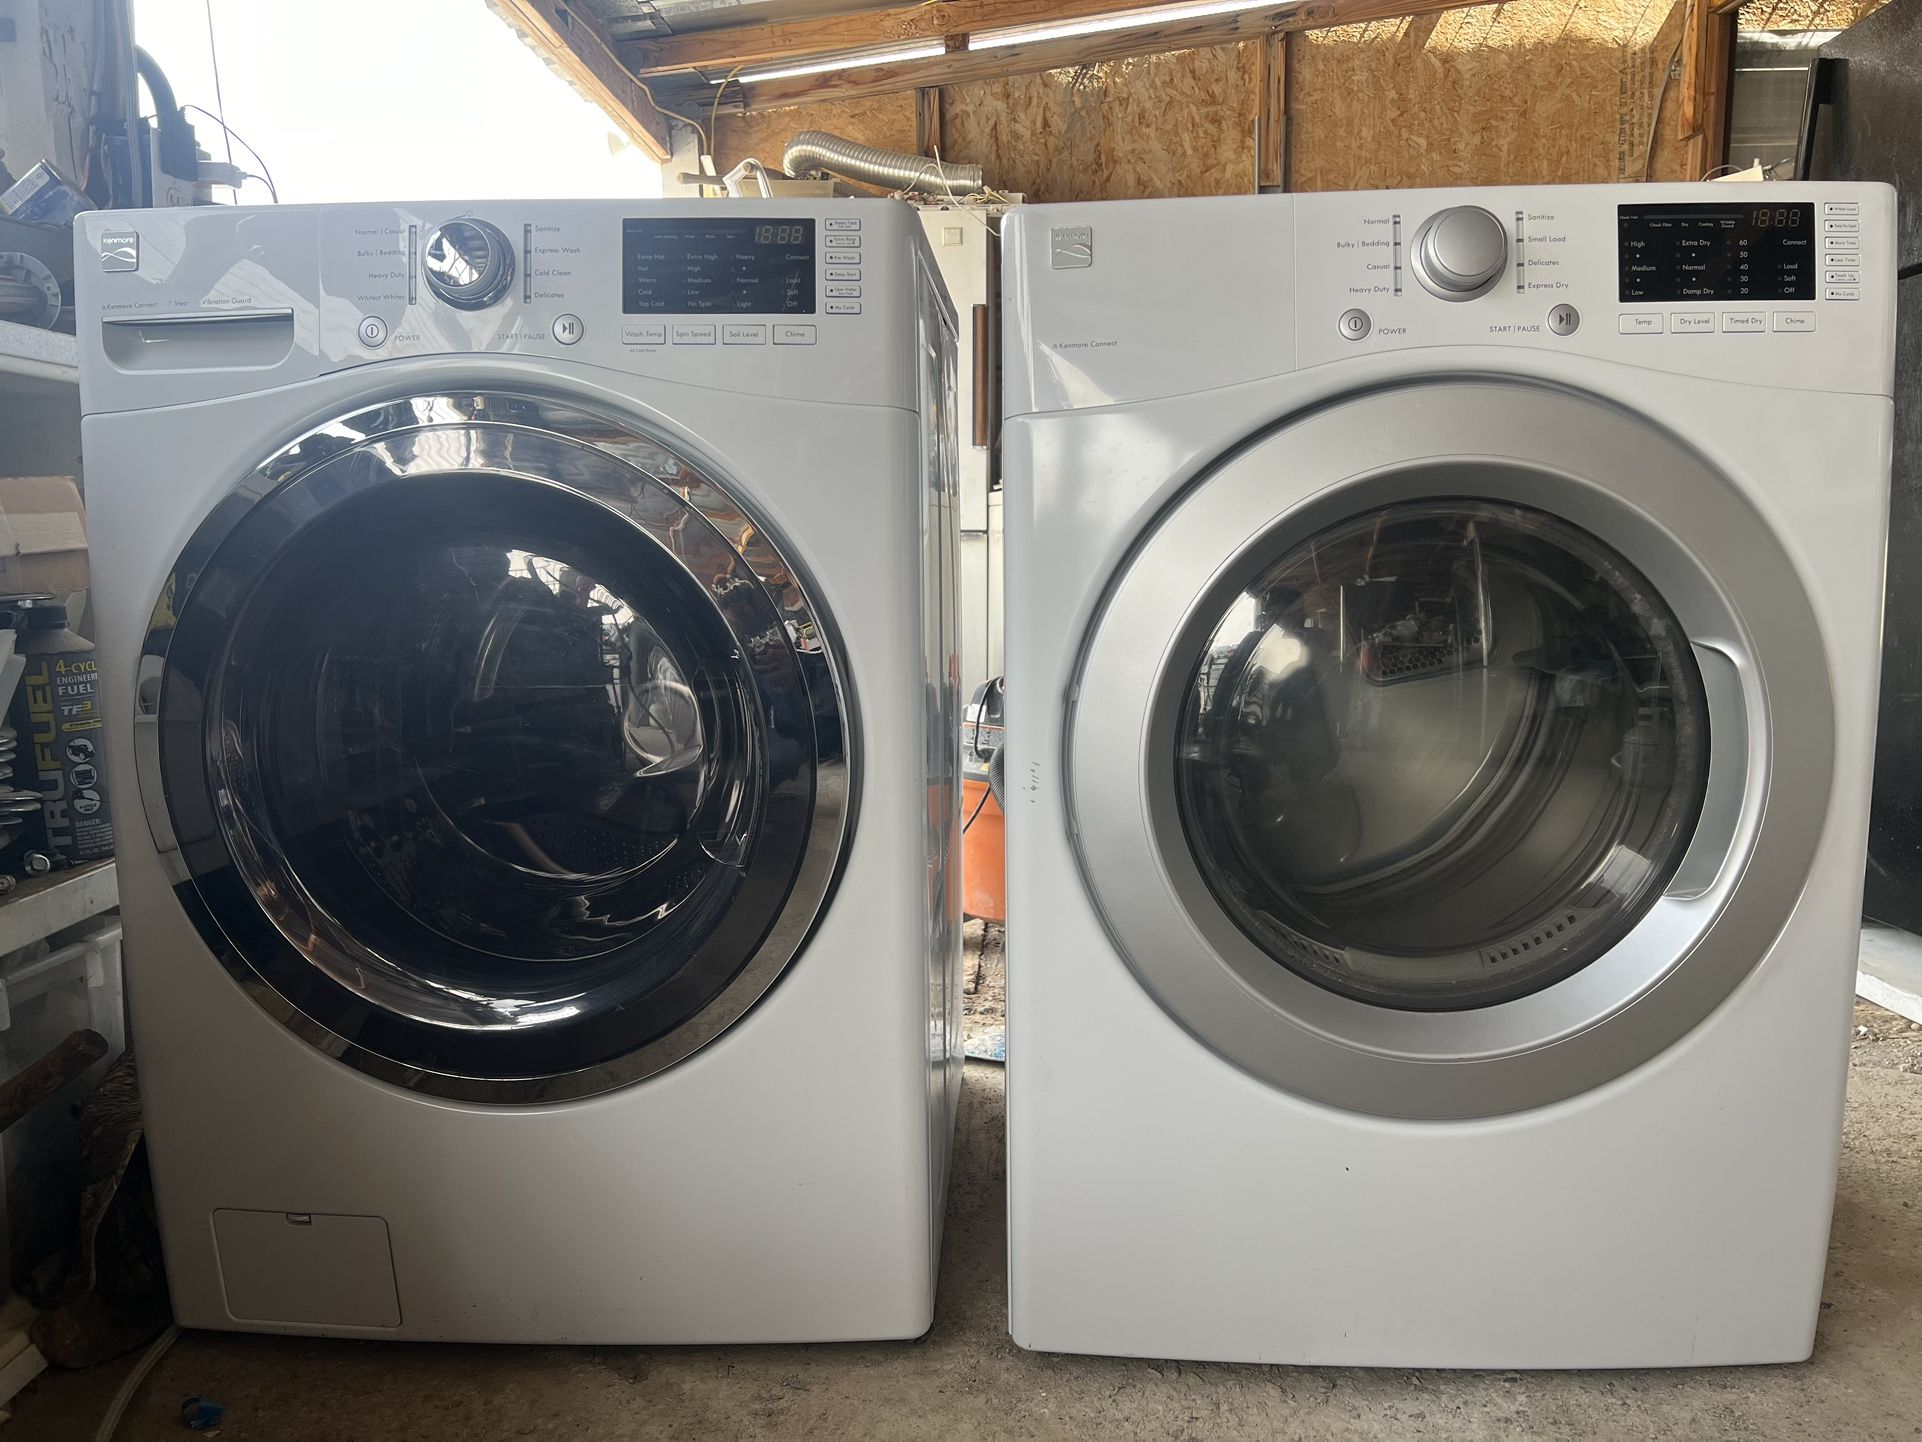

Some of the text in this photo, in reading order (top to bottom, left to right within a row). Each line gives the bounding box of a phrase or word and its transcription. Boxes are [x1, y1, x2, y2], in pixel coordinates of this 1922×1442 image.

[384, 227, 406, 235] Casual
[103, 236, 135, 245] Kenmore
[1361, 240, 1390, 248] Bedding
[380, 249, 405, 257] Bedding
[535, 247, 559, 255] Express
[705, 254, 718, 262] High
[687, 265, 701, 273] High
[369, 272, 405, 280] Heavy Duty
[1528, 282, 1569, 290] Express Dry
[1349, 286, 1390, 295] Heavy Duty
[202, 297, 252, 306] Vibration Guard
[134, 302, 158, 310] Connect
[1635, 319, 1652, 327] Temp
[1680, 318, 1692, 326] Dry
[1750, 317, 1763, 325] Dry
[644, 331, 663, 339] Temp
[676, 331, 711, 339] Spin Speed
[58, 683, 94, 695] FUEL
[25, 661, 72, 851] TRUFUEL
